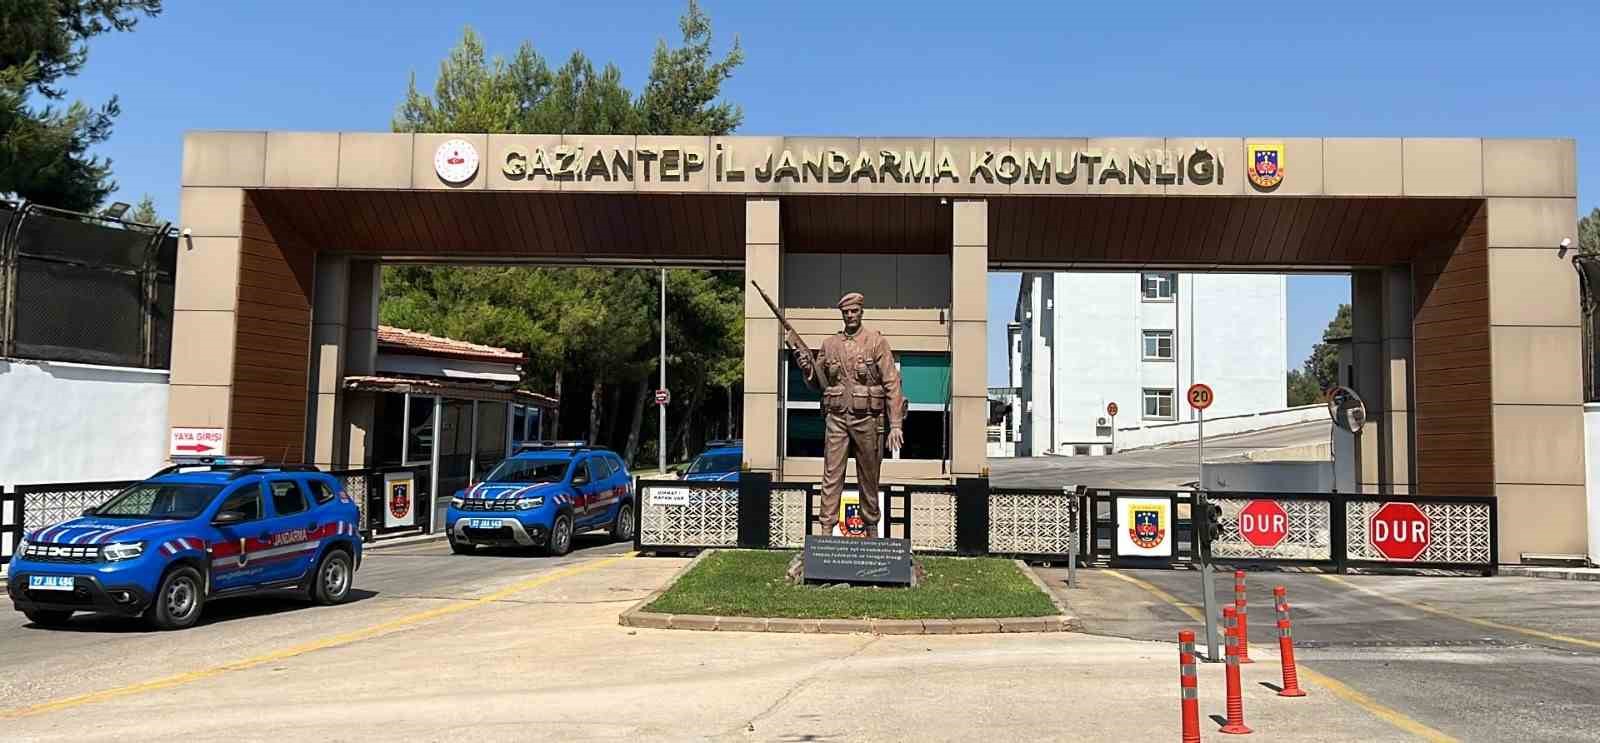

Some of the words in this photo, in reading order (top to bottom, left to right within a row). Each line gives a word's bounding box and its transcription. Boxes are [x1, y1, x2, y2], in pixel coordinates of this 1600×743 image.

[502, 145, 704, 182] GAZİANTEP
[715, 143, 745, 182] İL
[755, 147, 959, 183] JANDARMA
[969, 144, 1224, 185] KOMUTANLIĞI
[1193, 390, 1208, 402] 20
[174, 432, 194, 440] YAYA
[196, 431, 222, 442] GİRİŞİ
[1243, 514, 1285, 533] DUR
[1375, 520, 1426, 543] DUR
[33, 575, 42, 586] 27
